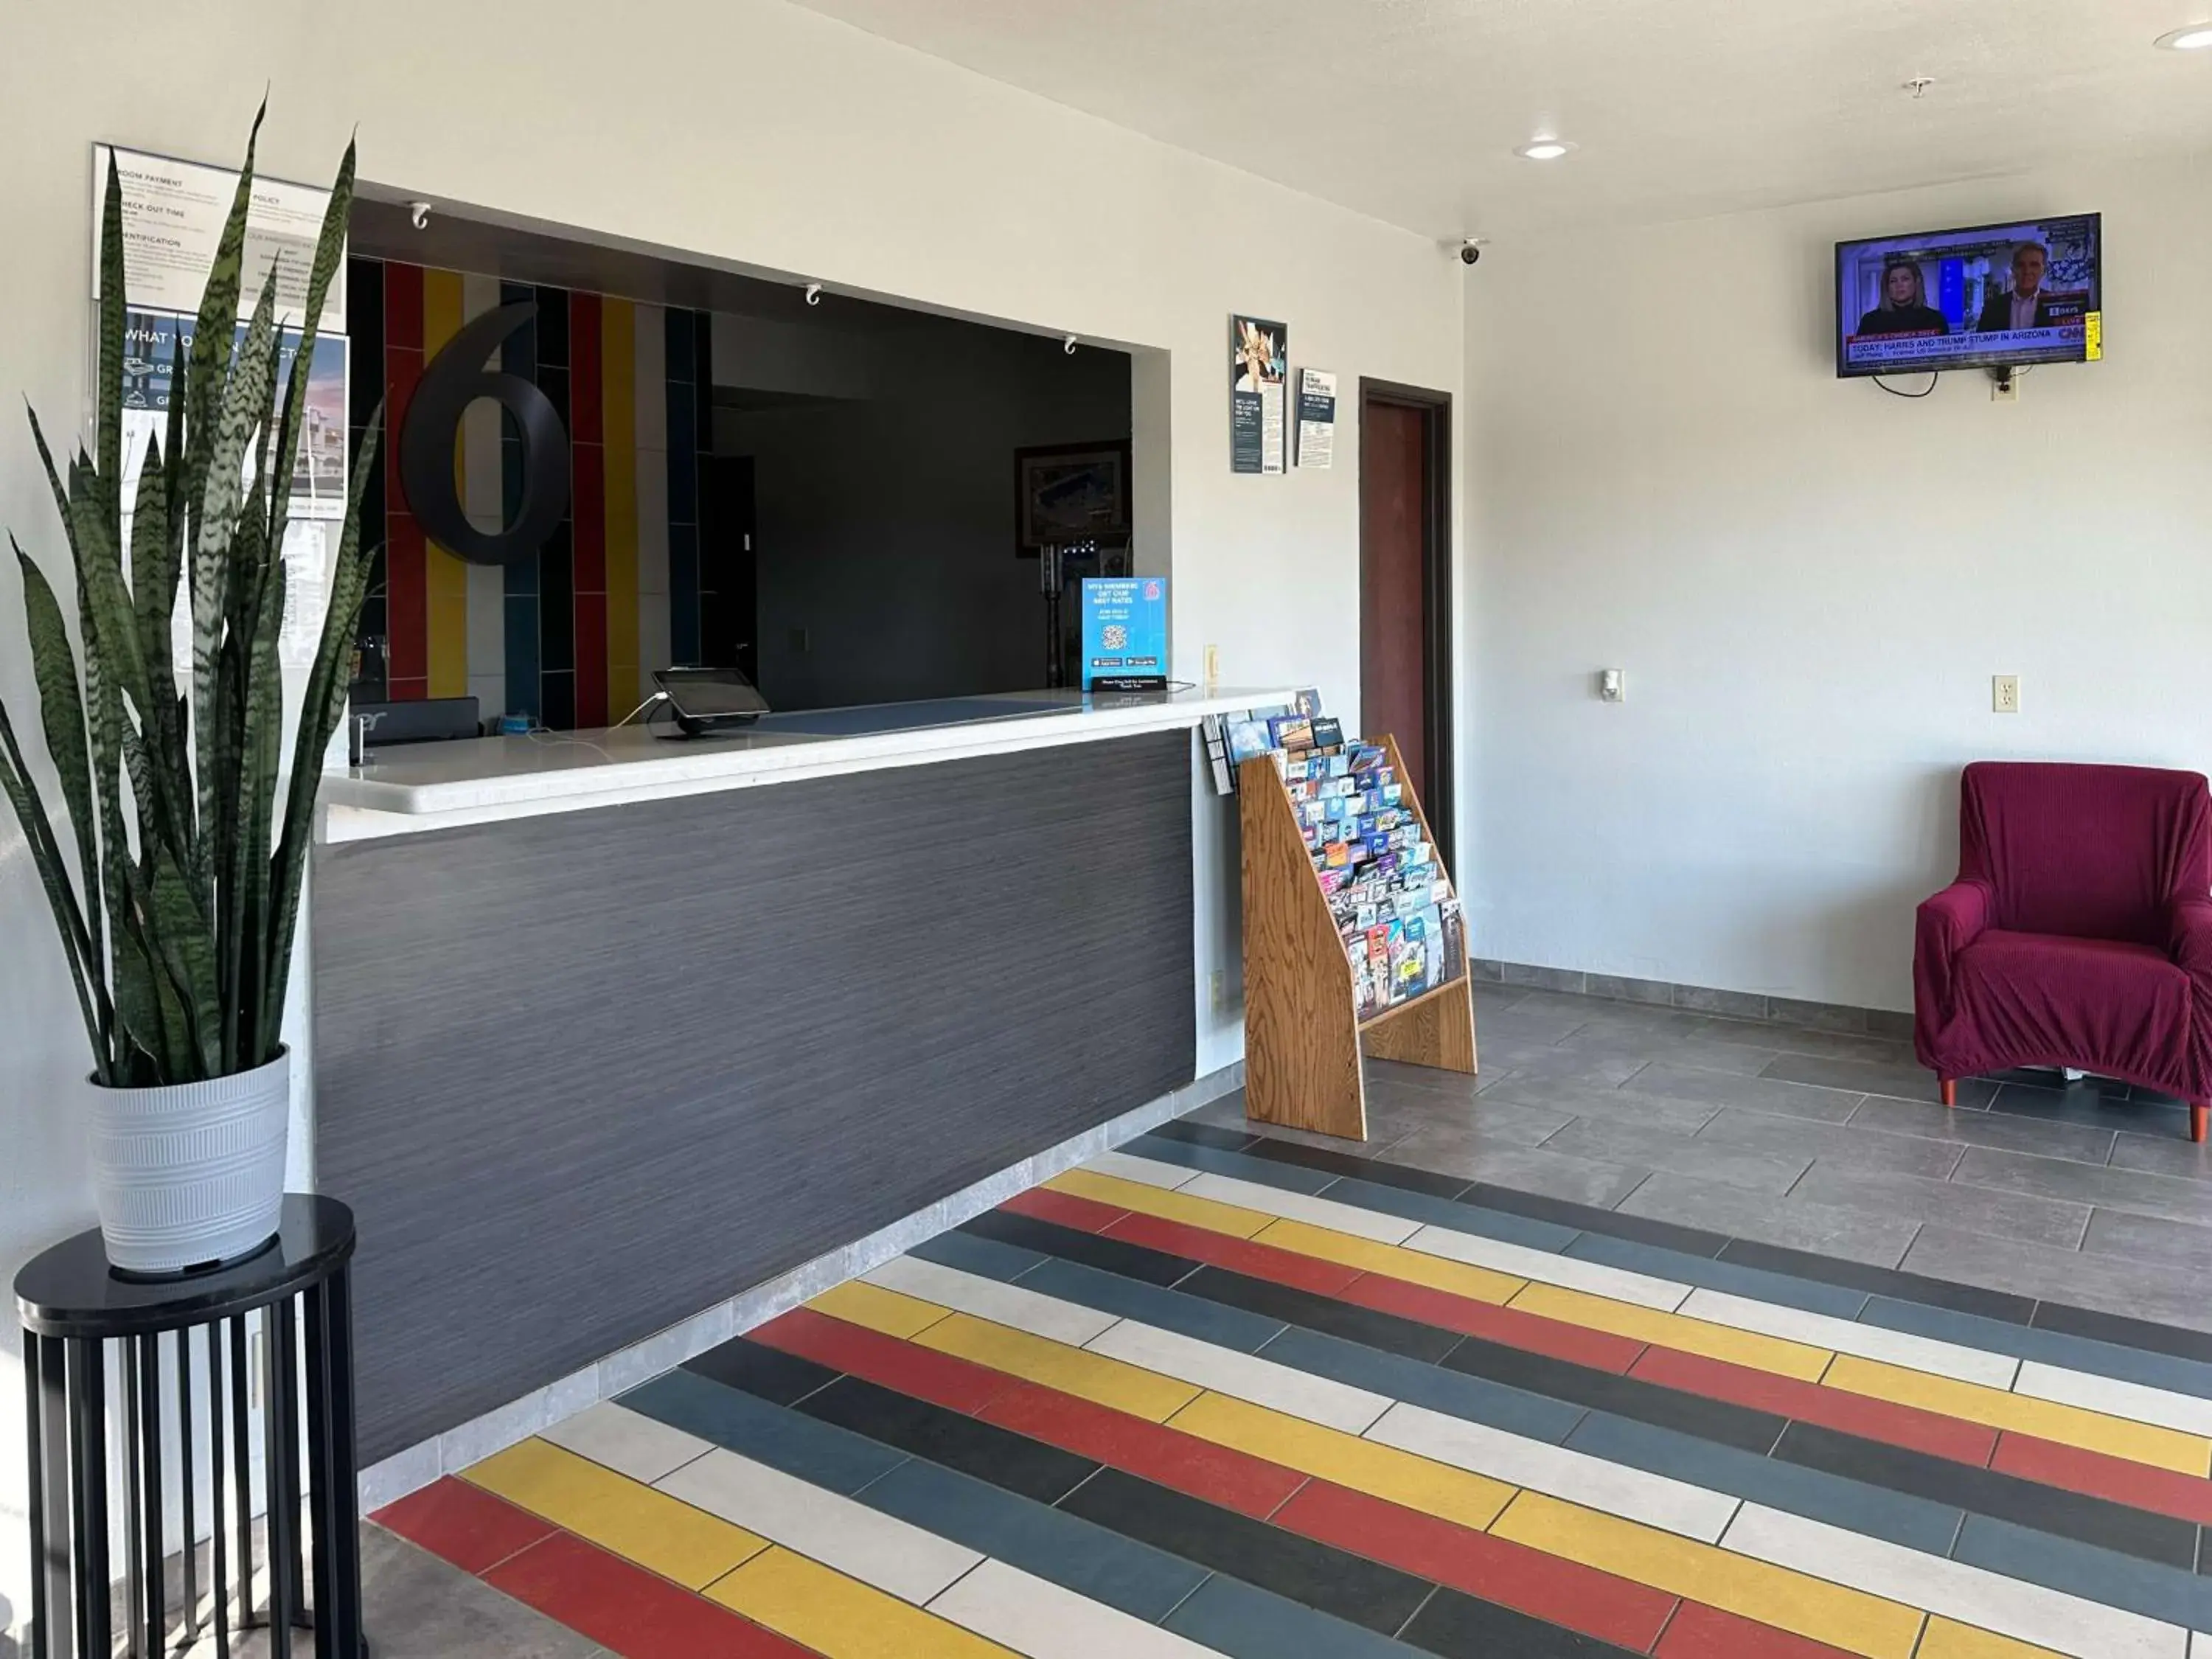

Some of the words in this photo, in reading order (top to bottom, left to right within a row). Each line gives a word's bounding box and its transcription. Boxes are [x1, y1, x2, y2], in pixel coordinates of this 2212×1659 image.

[145, 175, 183, 187] PAYMENT
[122, 201, 144, 210] HECK
[147, 205, 164, 213] OUT
[166, 209, 184, 218] TIME
[122, 232, 181, 248] ENTIFICATION
[125, 329, 168, 344] WHAT
[1884, 341, 1915, 350] HARRIS
[1916, 338, 1935, 347] AND
[1937, 335, 1966, 345] TRUMP
[2000, 332, 2009, 341] IN
[2012, 330, 2051, 340] ARIZONA
[399, 299, 570, 566] 6
